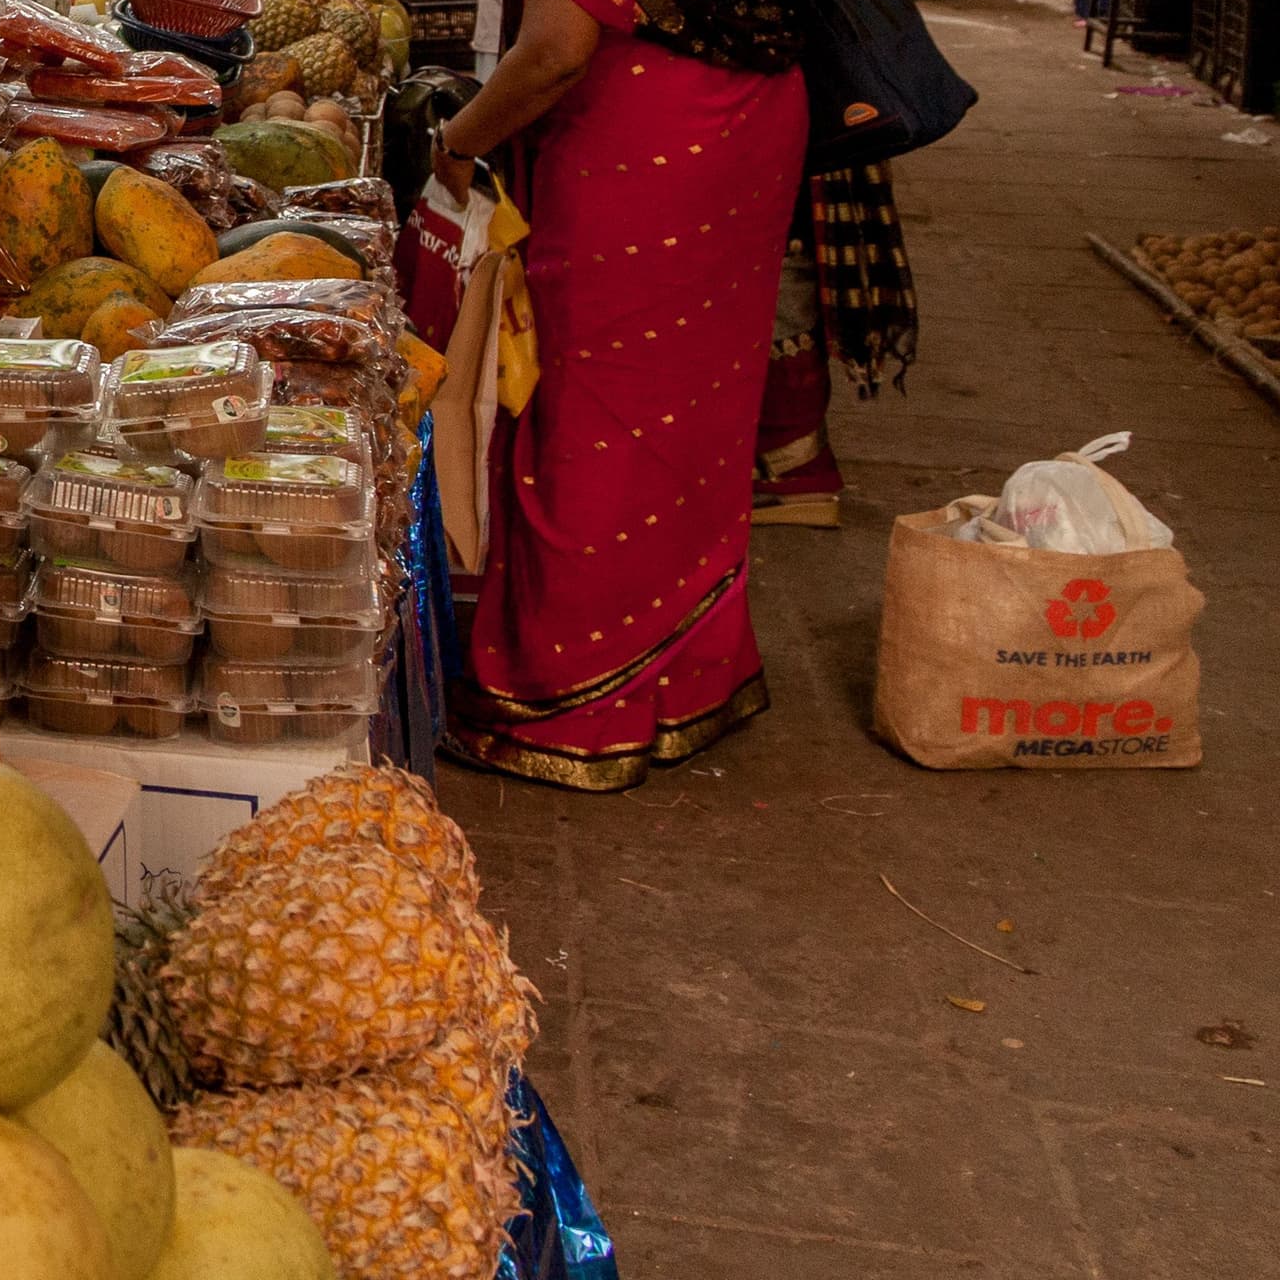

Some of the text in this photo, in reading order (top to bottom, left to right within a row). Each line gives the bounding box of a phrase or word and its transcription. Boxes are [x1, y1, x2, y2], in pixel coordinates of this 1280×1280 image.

[995, 649, 1152, 668] SAVE THE EARTH
[1013, 734, 1170, 759] MEGASTORE
